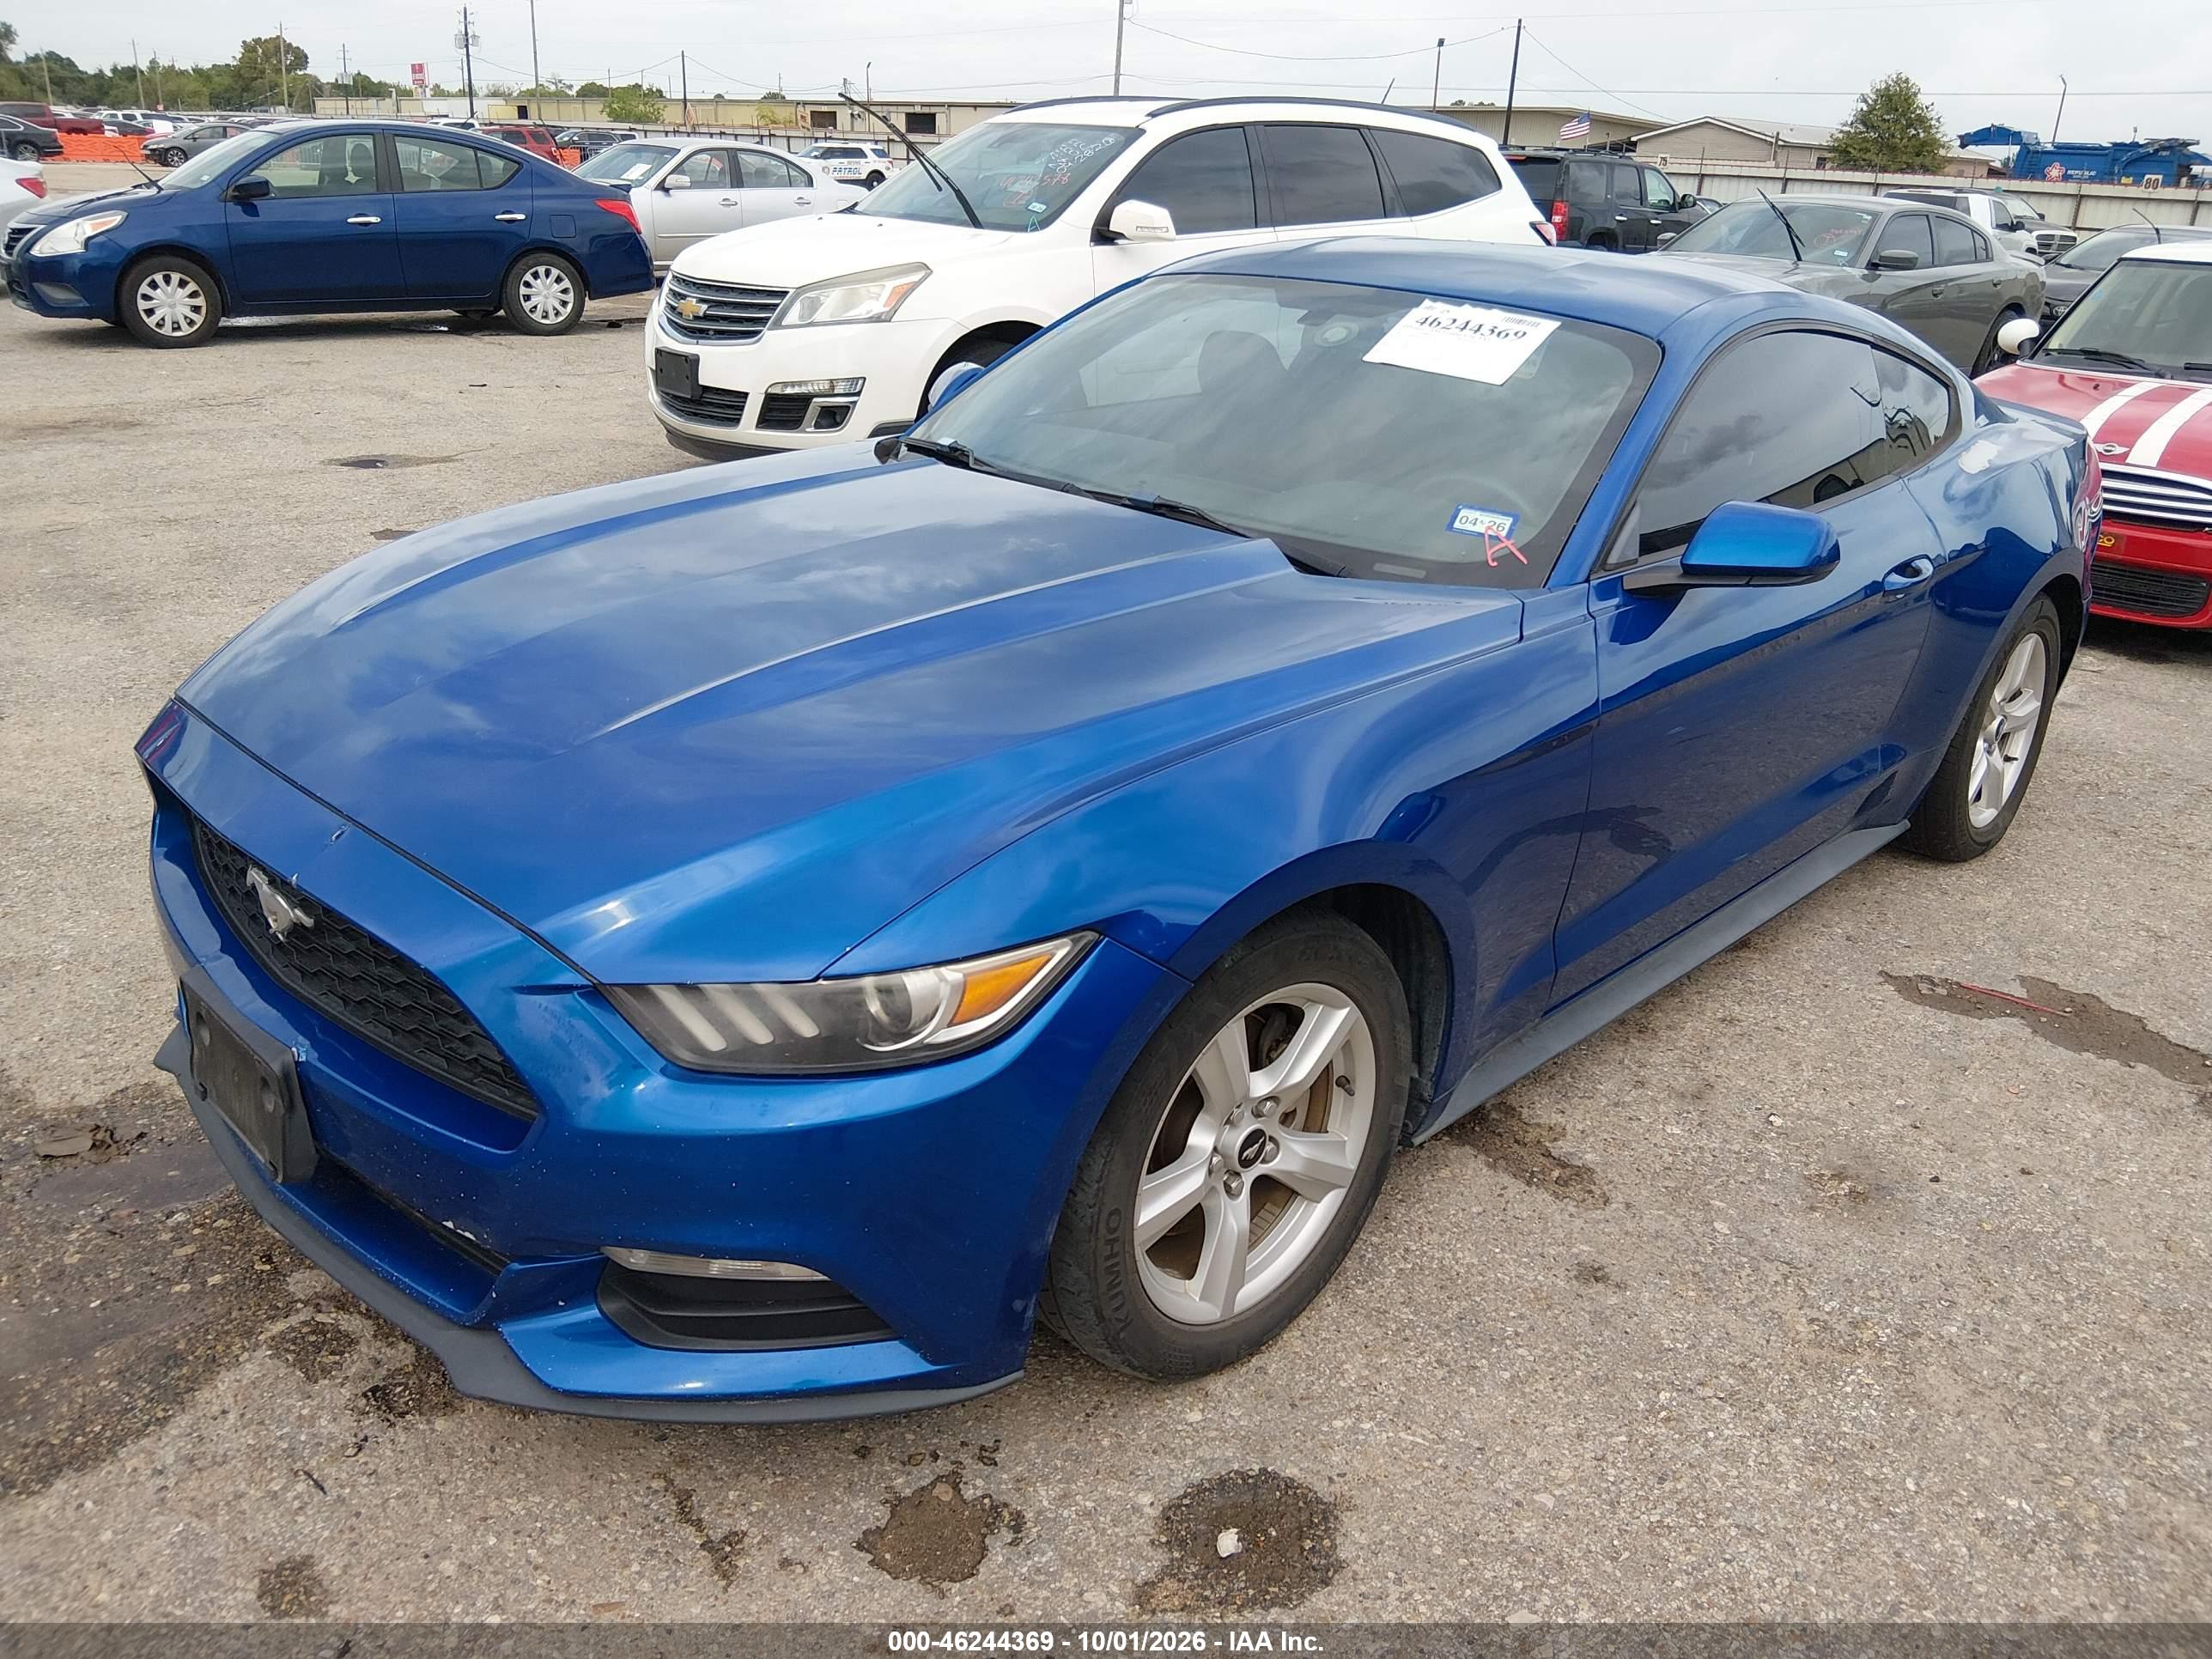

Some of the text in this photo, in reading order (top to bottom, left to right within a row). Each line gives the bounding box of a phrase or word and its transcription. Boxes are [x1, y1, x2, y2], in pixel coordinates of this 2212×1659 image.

[1658, 156, 1668, 167] 75
[831, 167, 862, 175] PATROL
[2144, 177, 2160, 190] 80
[1415, 315, 1528, 342] 46244369
[1459, 515, 1478, 526] 04
